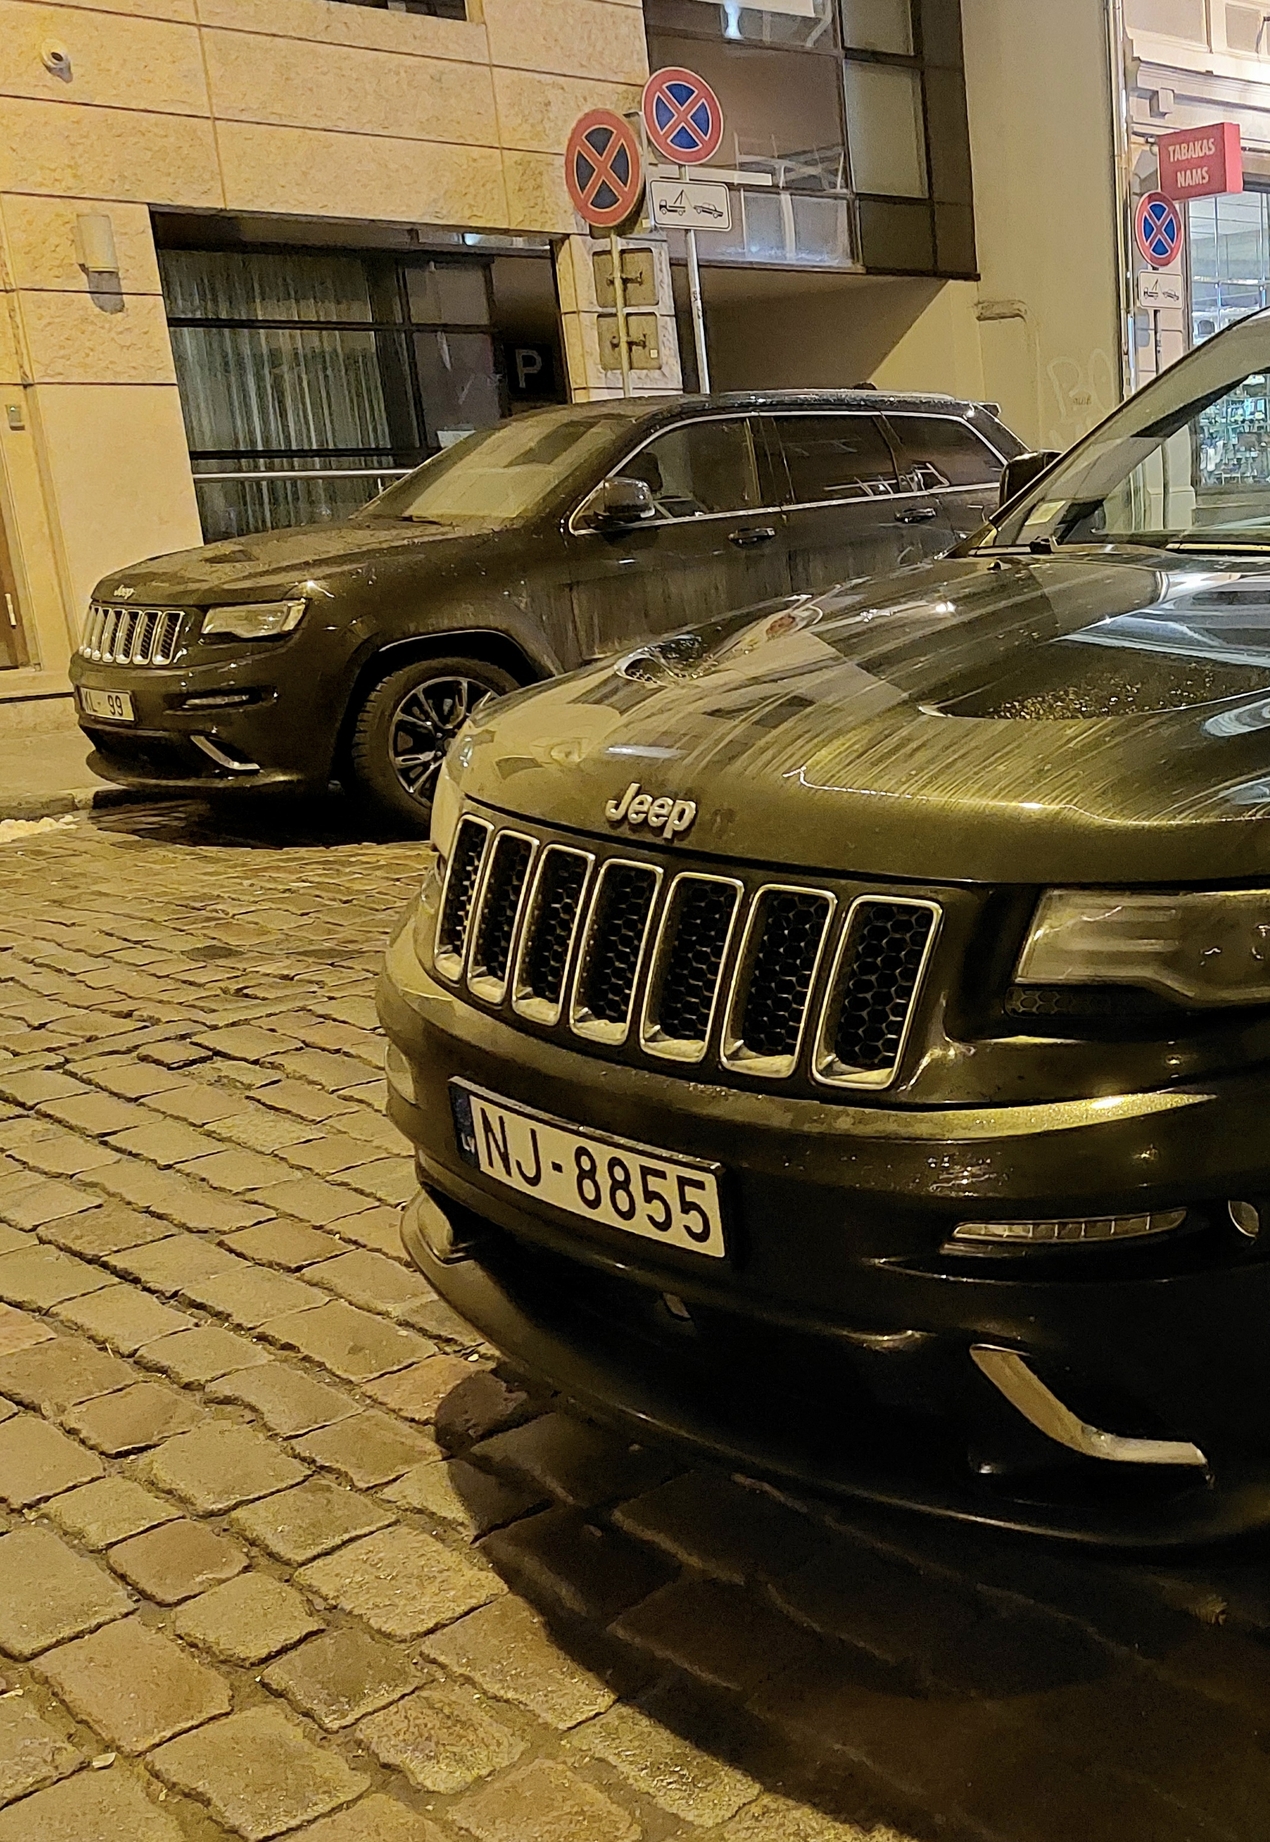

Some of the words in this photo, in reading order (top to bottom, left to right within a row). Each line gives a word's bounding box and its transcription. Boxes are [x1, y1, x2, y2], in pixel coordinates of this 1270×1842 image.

[1168, 137, 1216, 162] TABAKAS
[1176, 165, 1210, 188] NAMS
[515, 349, 543, 388] P
[605, 782, 697, 840] Jeep
[479, 1106, 711, 1244] NJ-8855
